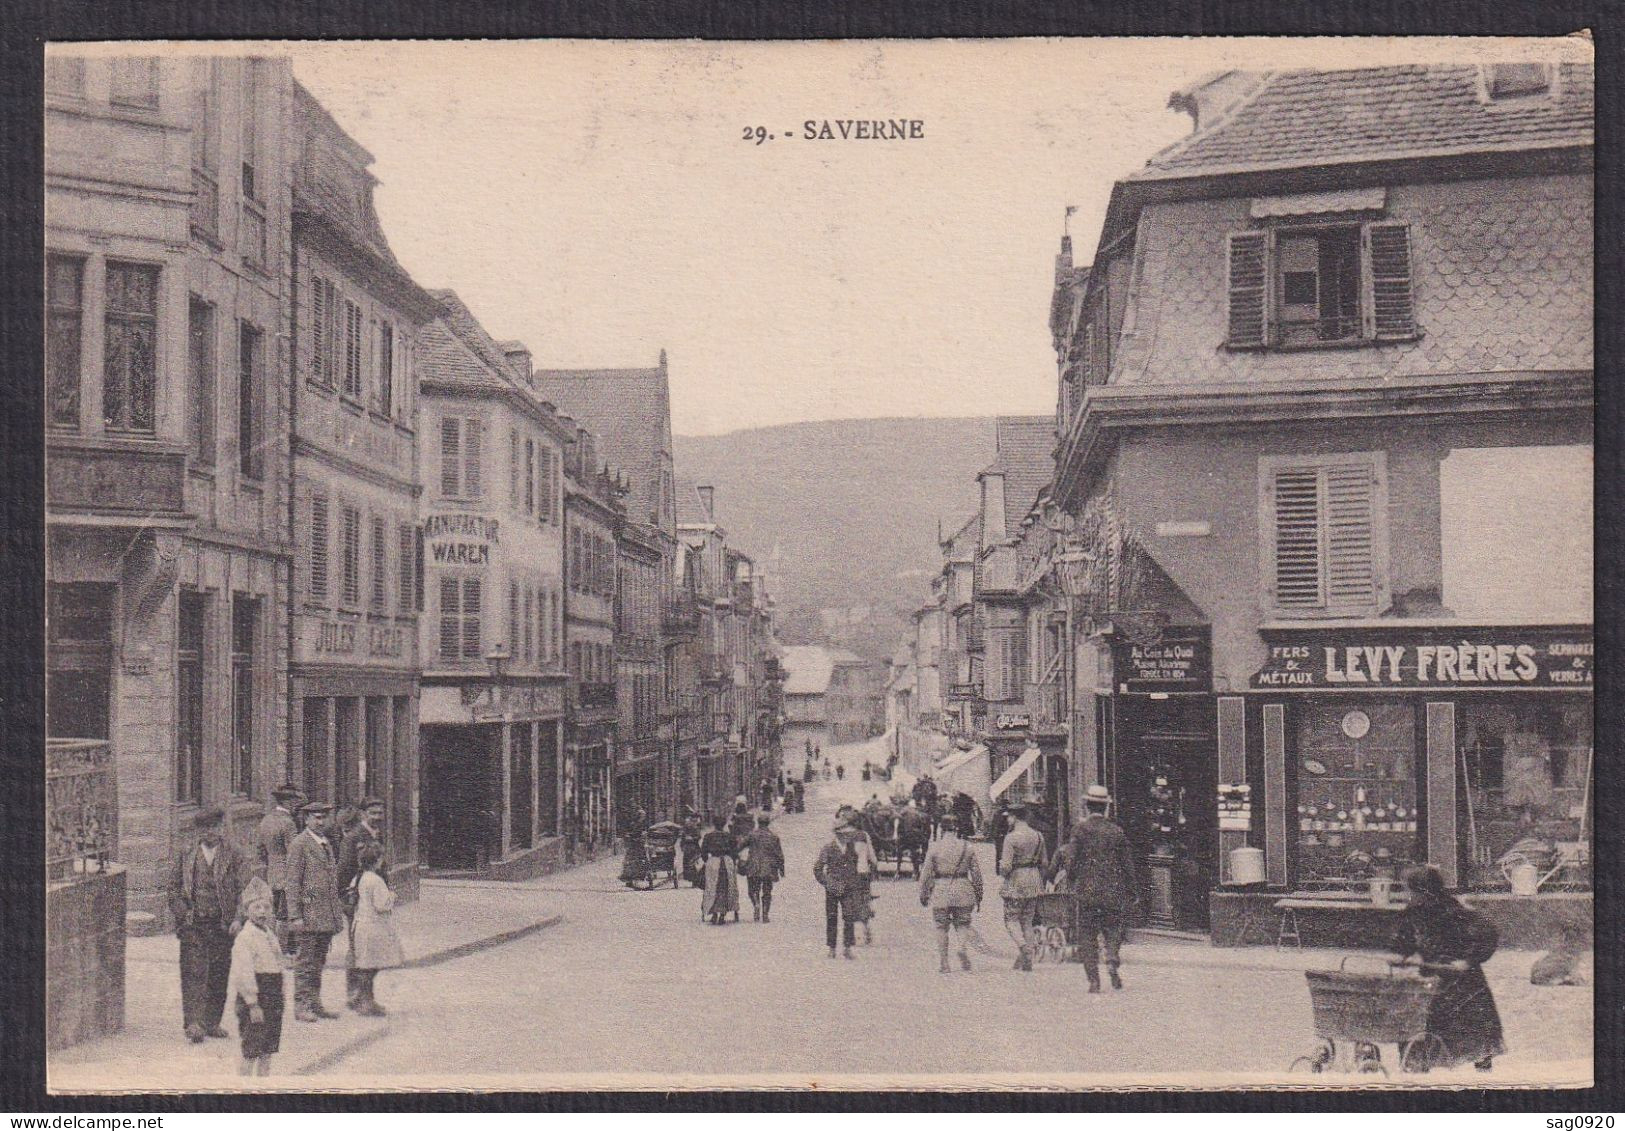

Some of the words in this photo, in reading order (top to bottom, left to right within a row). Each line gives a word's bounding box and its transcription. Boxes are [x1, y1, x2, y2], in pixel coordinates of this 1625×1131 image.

[432, 543, 489, 564] WAREN
[1273, 646, 1310, 658] FERS
[1286, 659, 1300, 670] &
[1323, 646, 1406, 682] LEVY
[1416, 640, 1538, 681] FRÈRES
[1572, 657, 1586, 668] &
[1258, 670, 1313, 685] MÉTAUX
